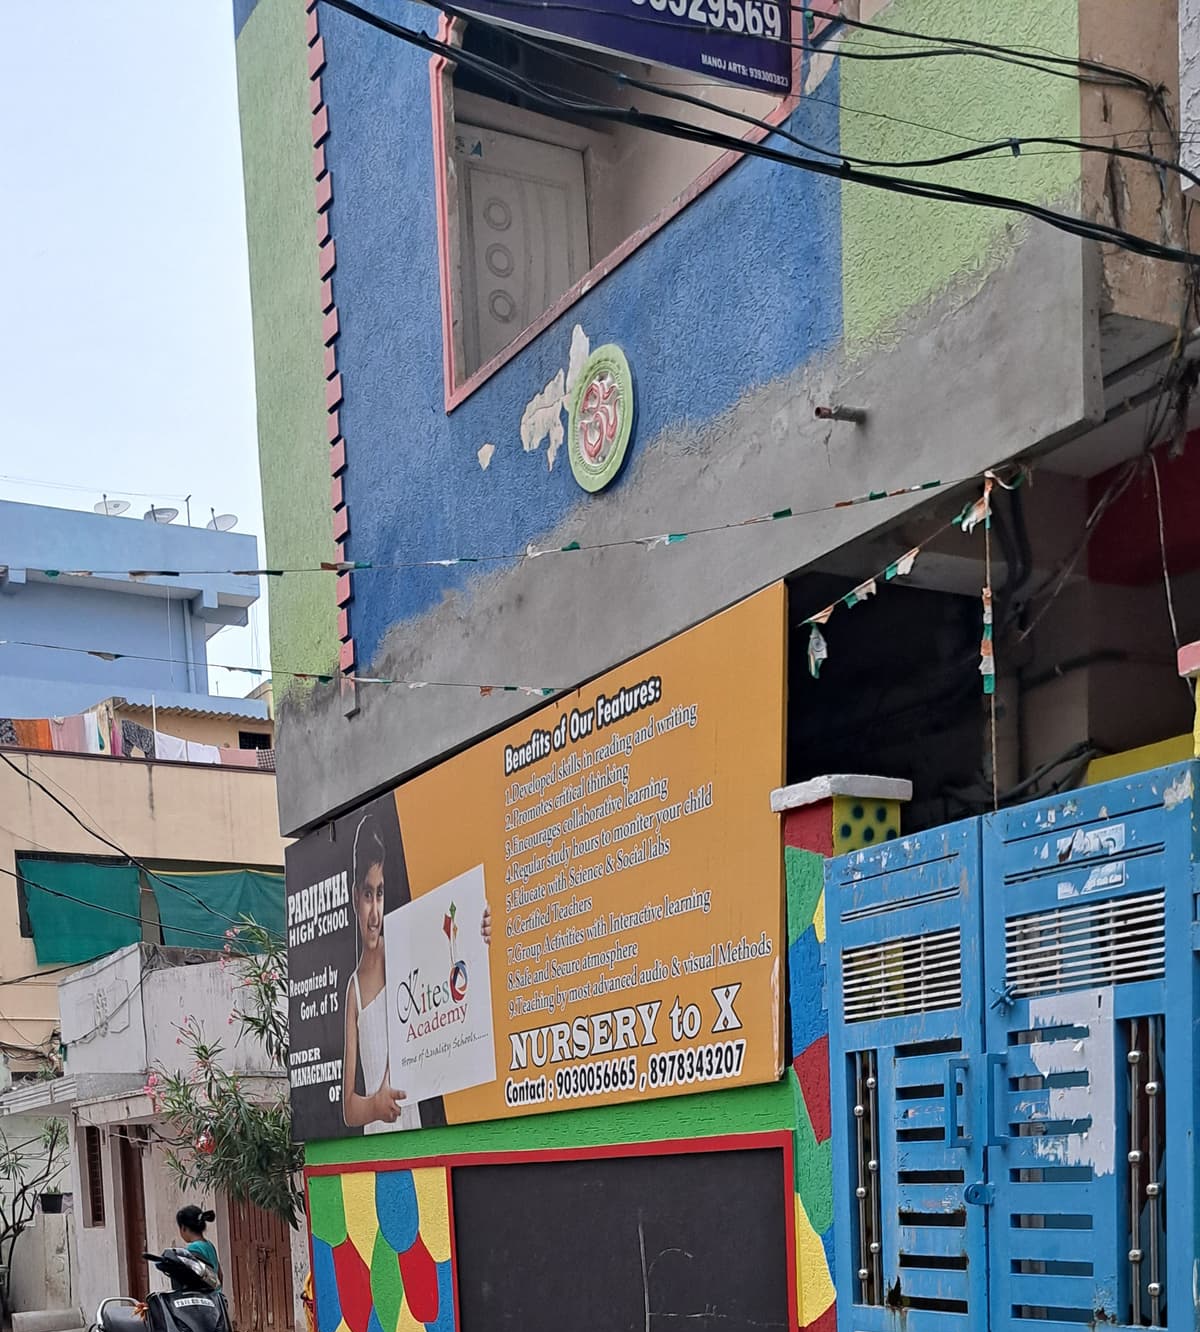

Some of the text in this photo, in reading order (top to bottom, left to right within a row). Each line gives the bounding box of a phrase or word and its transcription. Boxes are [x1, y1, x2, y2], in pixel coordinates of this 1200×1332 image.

[701, 53, 726, 70] MANOJ
[504, 676, 661, 776] Benefits of Our Features:
[505, 703, 698, 806] 1.Developed skills in reading and writing
[505, 764, 629, 831] 2.Promotes critical thinking
[505, 776, 668, 859] 3.Encourages collaborative learning
[505, 783, 713, 884] 4.Regular study hours to moniter your child
[288, 870, 349, 927] PARIJATHA
[505, 835, 670, 913] 5.Educate with Science & Social labs
[289, 907, 349, 948] HIGH SCHOOL
[506, 895, 593, 937] 6.Certified Teachers
[507, 888, 711, 964] 7.Group Activities with Interactive learning
[289, 965, 338, 997] Recognized by
[507, 942, 638, 991] 8.Safe and Secure atmosphere
[508, 931, 772, 1019] 9.Teaching by most advanced audio & visual Methods
[300, 992, 339, 1021] Govt. of TS
[406, 1003, 467, 1043] Academy
[508, 983, 743, 1071] NURSERY to X
[290, 1047, 321, 1066] UNDER
[290, 1059, 342, 1088] MANAGEMENT
[425, 1043, 451, 1058] Quality
[506, 1075, 545, 1106] Contact
[555, 1057, 637, 1098] 9030056665
[649, 1040, 746, 1082] 8978343207
[329, 1085, 342, 1103] OF
